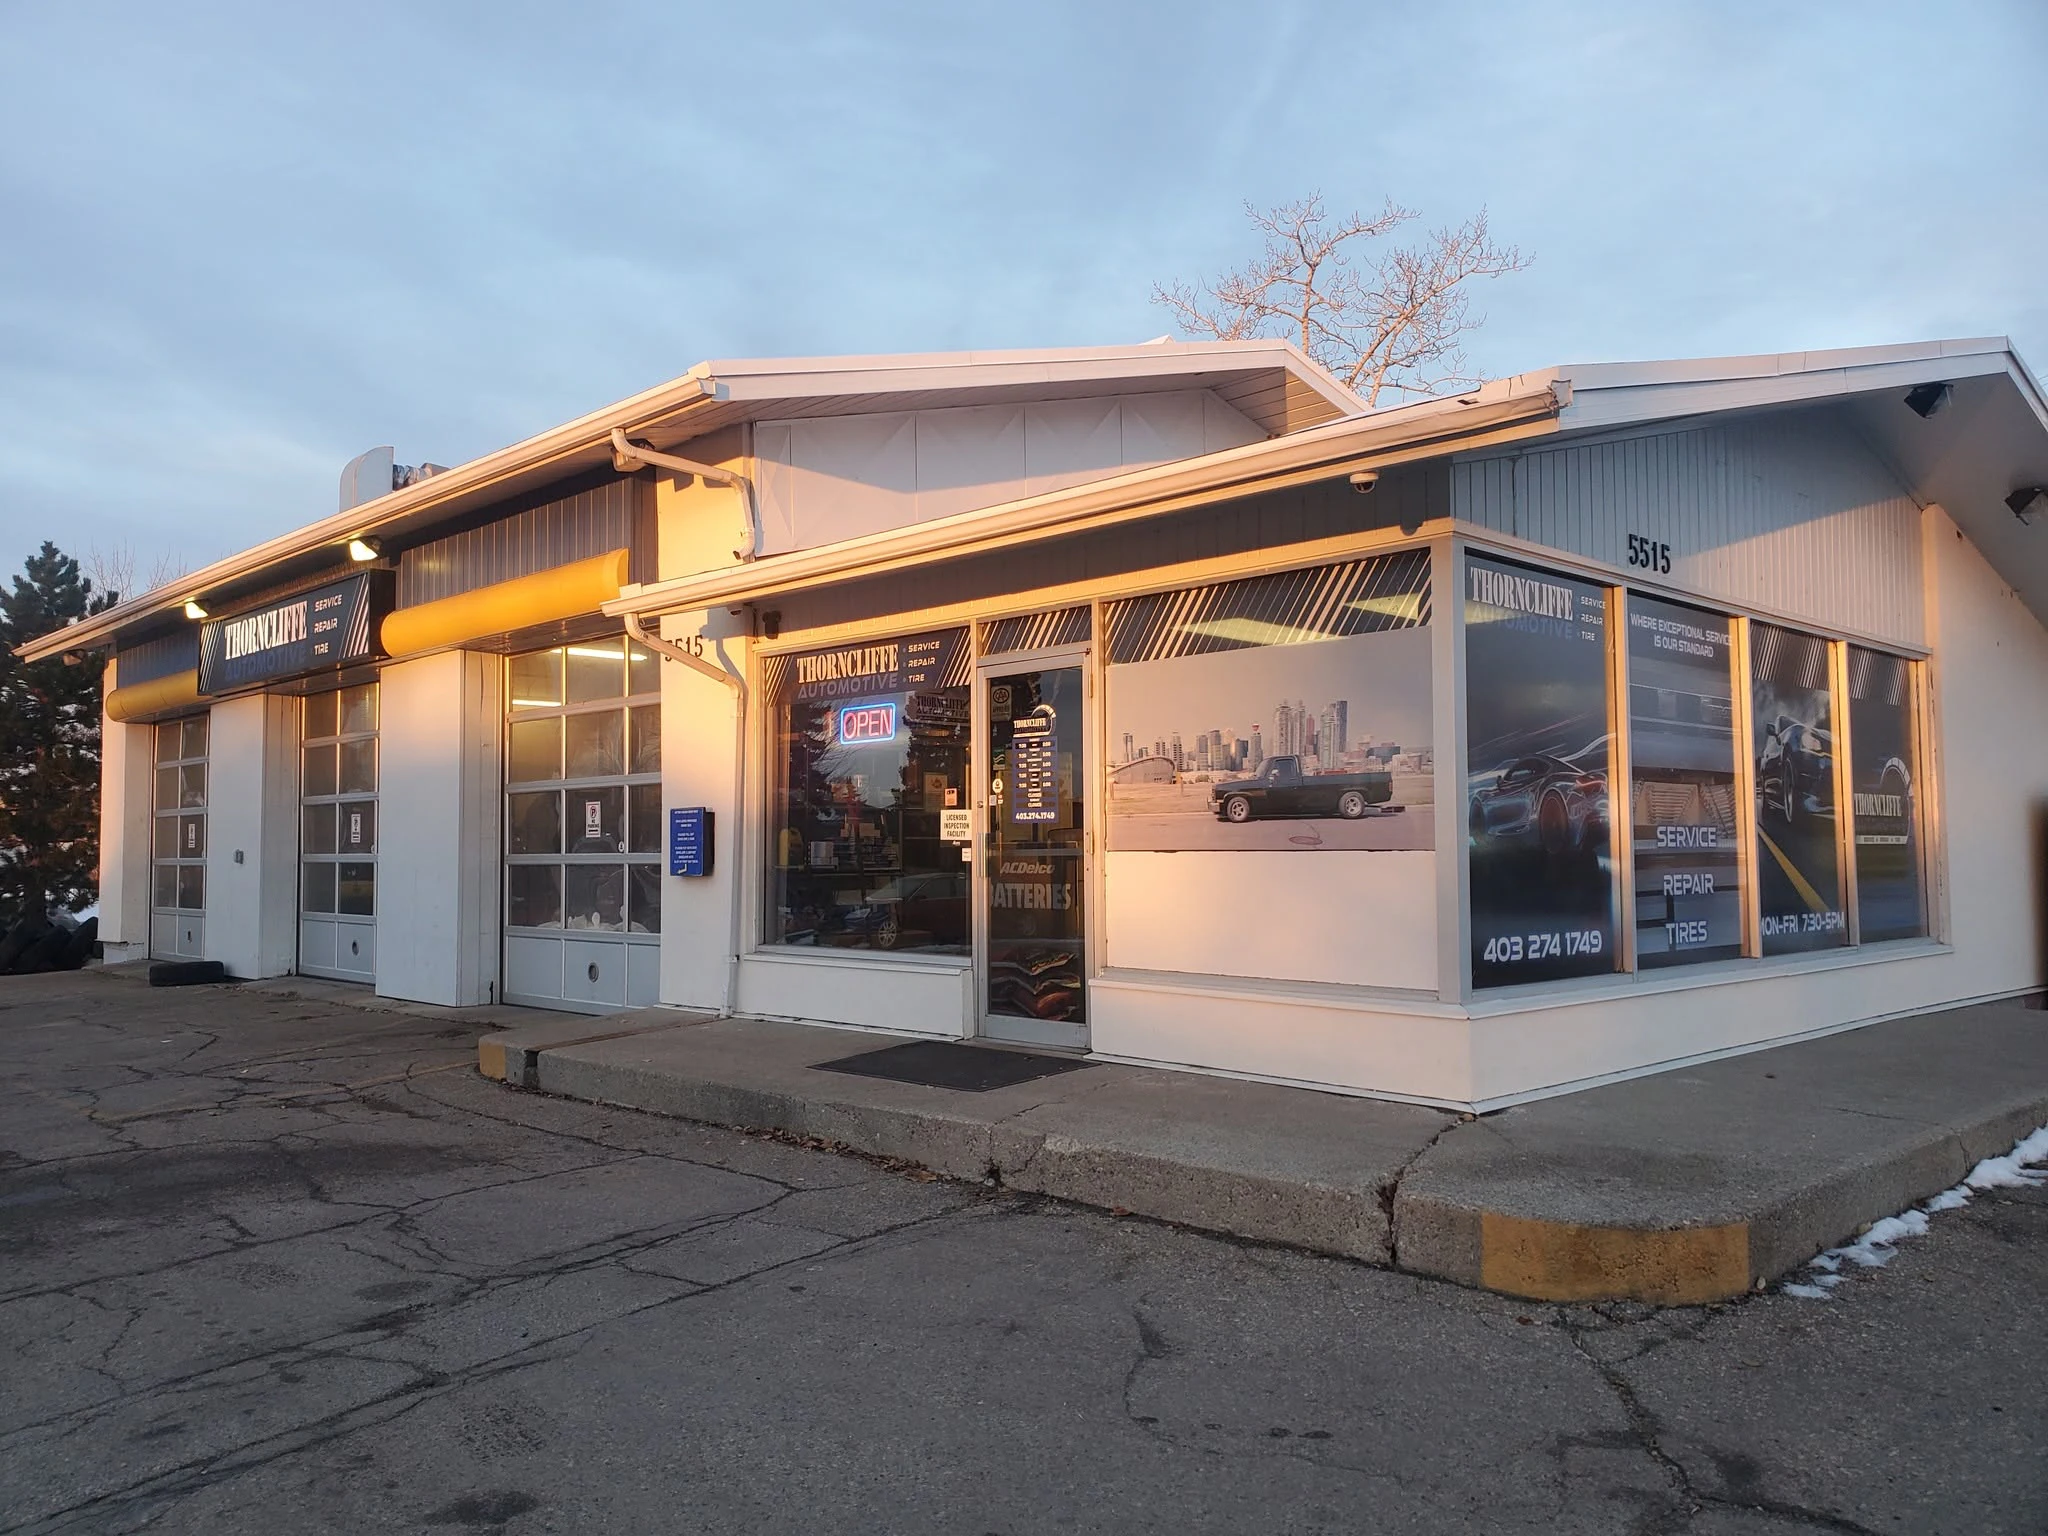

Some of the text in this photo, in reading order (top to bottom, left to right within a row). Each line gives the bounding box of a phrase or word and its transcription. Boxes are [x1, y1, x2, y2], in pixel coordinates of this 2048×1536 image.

[1629, 533, 1671, 574] 5515
[315, 594, 342, 612] SERVICE
[1471, 567, 1573, 621] THORNCLIFFE
[1581, 596, 1606, 609] SERVICE
[225, 600, 307, 660] THORNCLIFFE
[314, 617, 338, 634] REPAIR
[1581, 614, 1603, 626] REPAIR
[1631, 613, 1733, 647] WHERE EXCEPTIONAL SERVICE
[908, 641, 940, 653] SERVICE
[1581, 631, 1595, 641] TIRE
[1654, 635, 1714, 658] IS OUR STANDARD
[314, 642, 329, 656] TIRE
[797, 644, 898, 683] THORNCLIFFE
[908, 657, 936, 668] REPAIR
[798, 672, 898, 699] AUTOMOTIVE
[908, 674, 925, 683] TIRE
[844, 708, 893, 739] OPEN
[1015, 812, 1055, 820] 403.274.1749
[1854, 793, 1902, 817] THORNCLIFFE
[1657, 826, 1717, 848] SERVICE
[1000, 861, 1056, 874] ACDelco
[990, 882, 1072, 910] ATTERIES
[1663, 873, 1714, 896] REPAIR
[1665, 920, 1707, 945] TIRES
[1484, 930, 1602, 963] 403 274 1749
